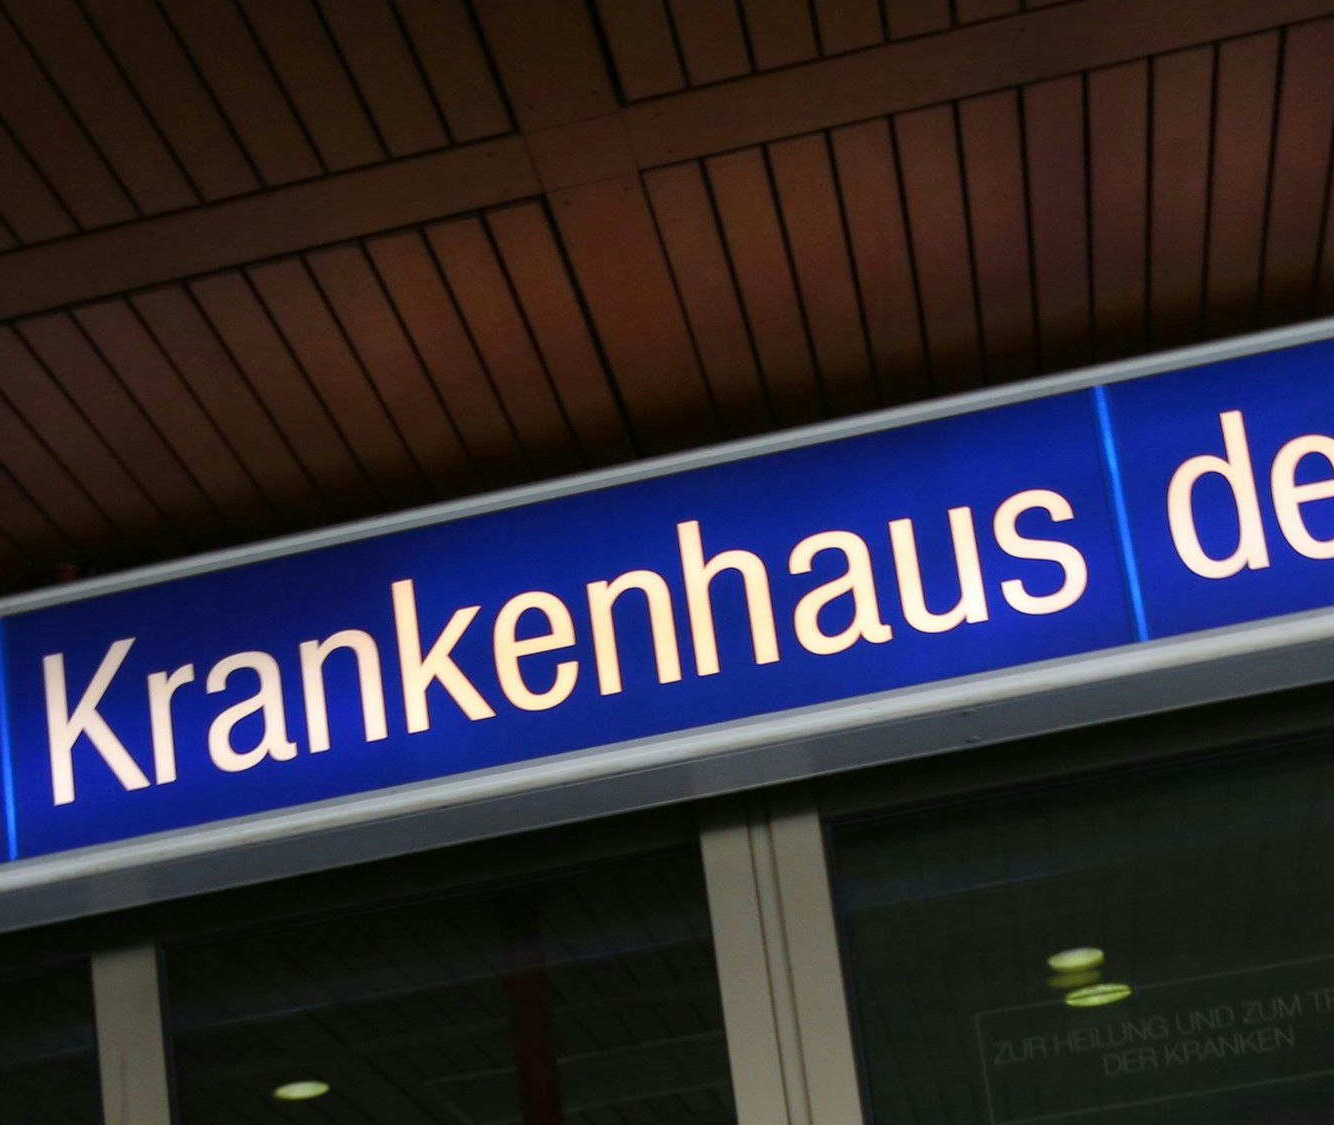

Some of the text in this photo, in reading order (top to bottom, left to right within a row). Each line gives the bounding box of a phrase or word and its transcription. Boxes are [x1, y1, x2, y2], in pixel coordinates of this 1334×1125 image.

[44, 489, 1088, 806] Krankenhaus
[992, 1035, 1048, 1066] ZUR
[1051, 1017, 1170, 1055] HEILUNG
[1175, 1005, 1235, 1036] UND
[1241, 994, 1302, 1026] ZUM
[1101, 1026, 1296, 1077] DER KRANKEN
